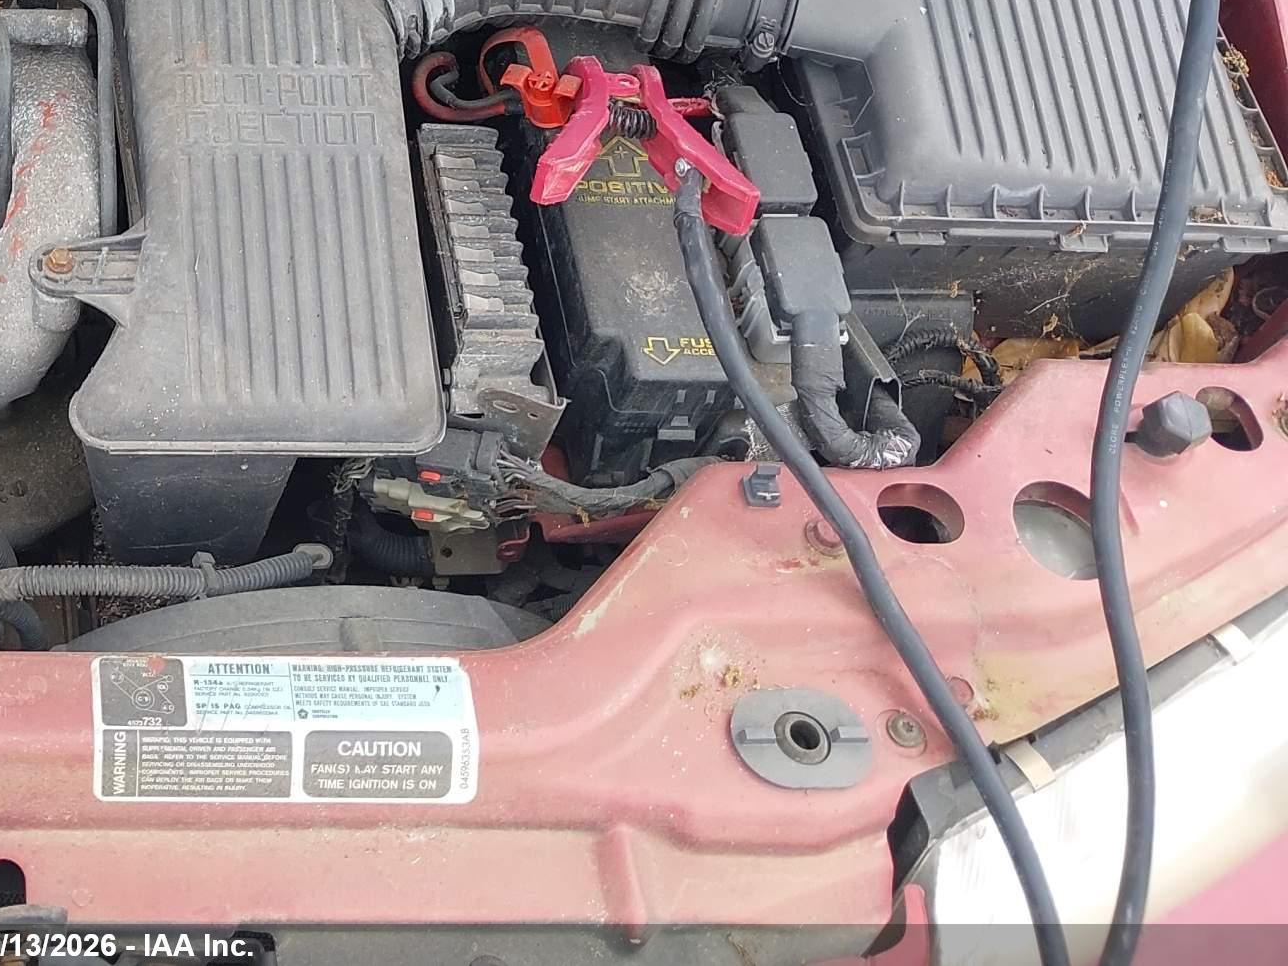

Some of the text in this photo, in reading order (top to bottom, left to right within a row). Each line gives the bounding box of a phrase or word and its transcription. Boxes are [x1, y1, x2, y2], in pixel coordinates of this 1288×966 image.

[177, 111, 380, 146] INJECTION
[575, 180, 670, 194] POSITIV
[679, 337, 713, 348] FUS
[683, 348, 716, 356] ACCE
[208, 663, 271, 675] ATTENTION
[293, 674, 302, 682] TO
[337, 740, 422, 757] CAUTION
[113, 731, 127, 795] WARNING
[311, 763, 351, 775] FAN(S)
[381, 764, 418, 775] START
[420, 765, 444, 775] ANY
[317, 778, 437, 790] TIME IGNITION IS ON
